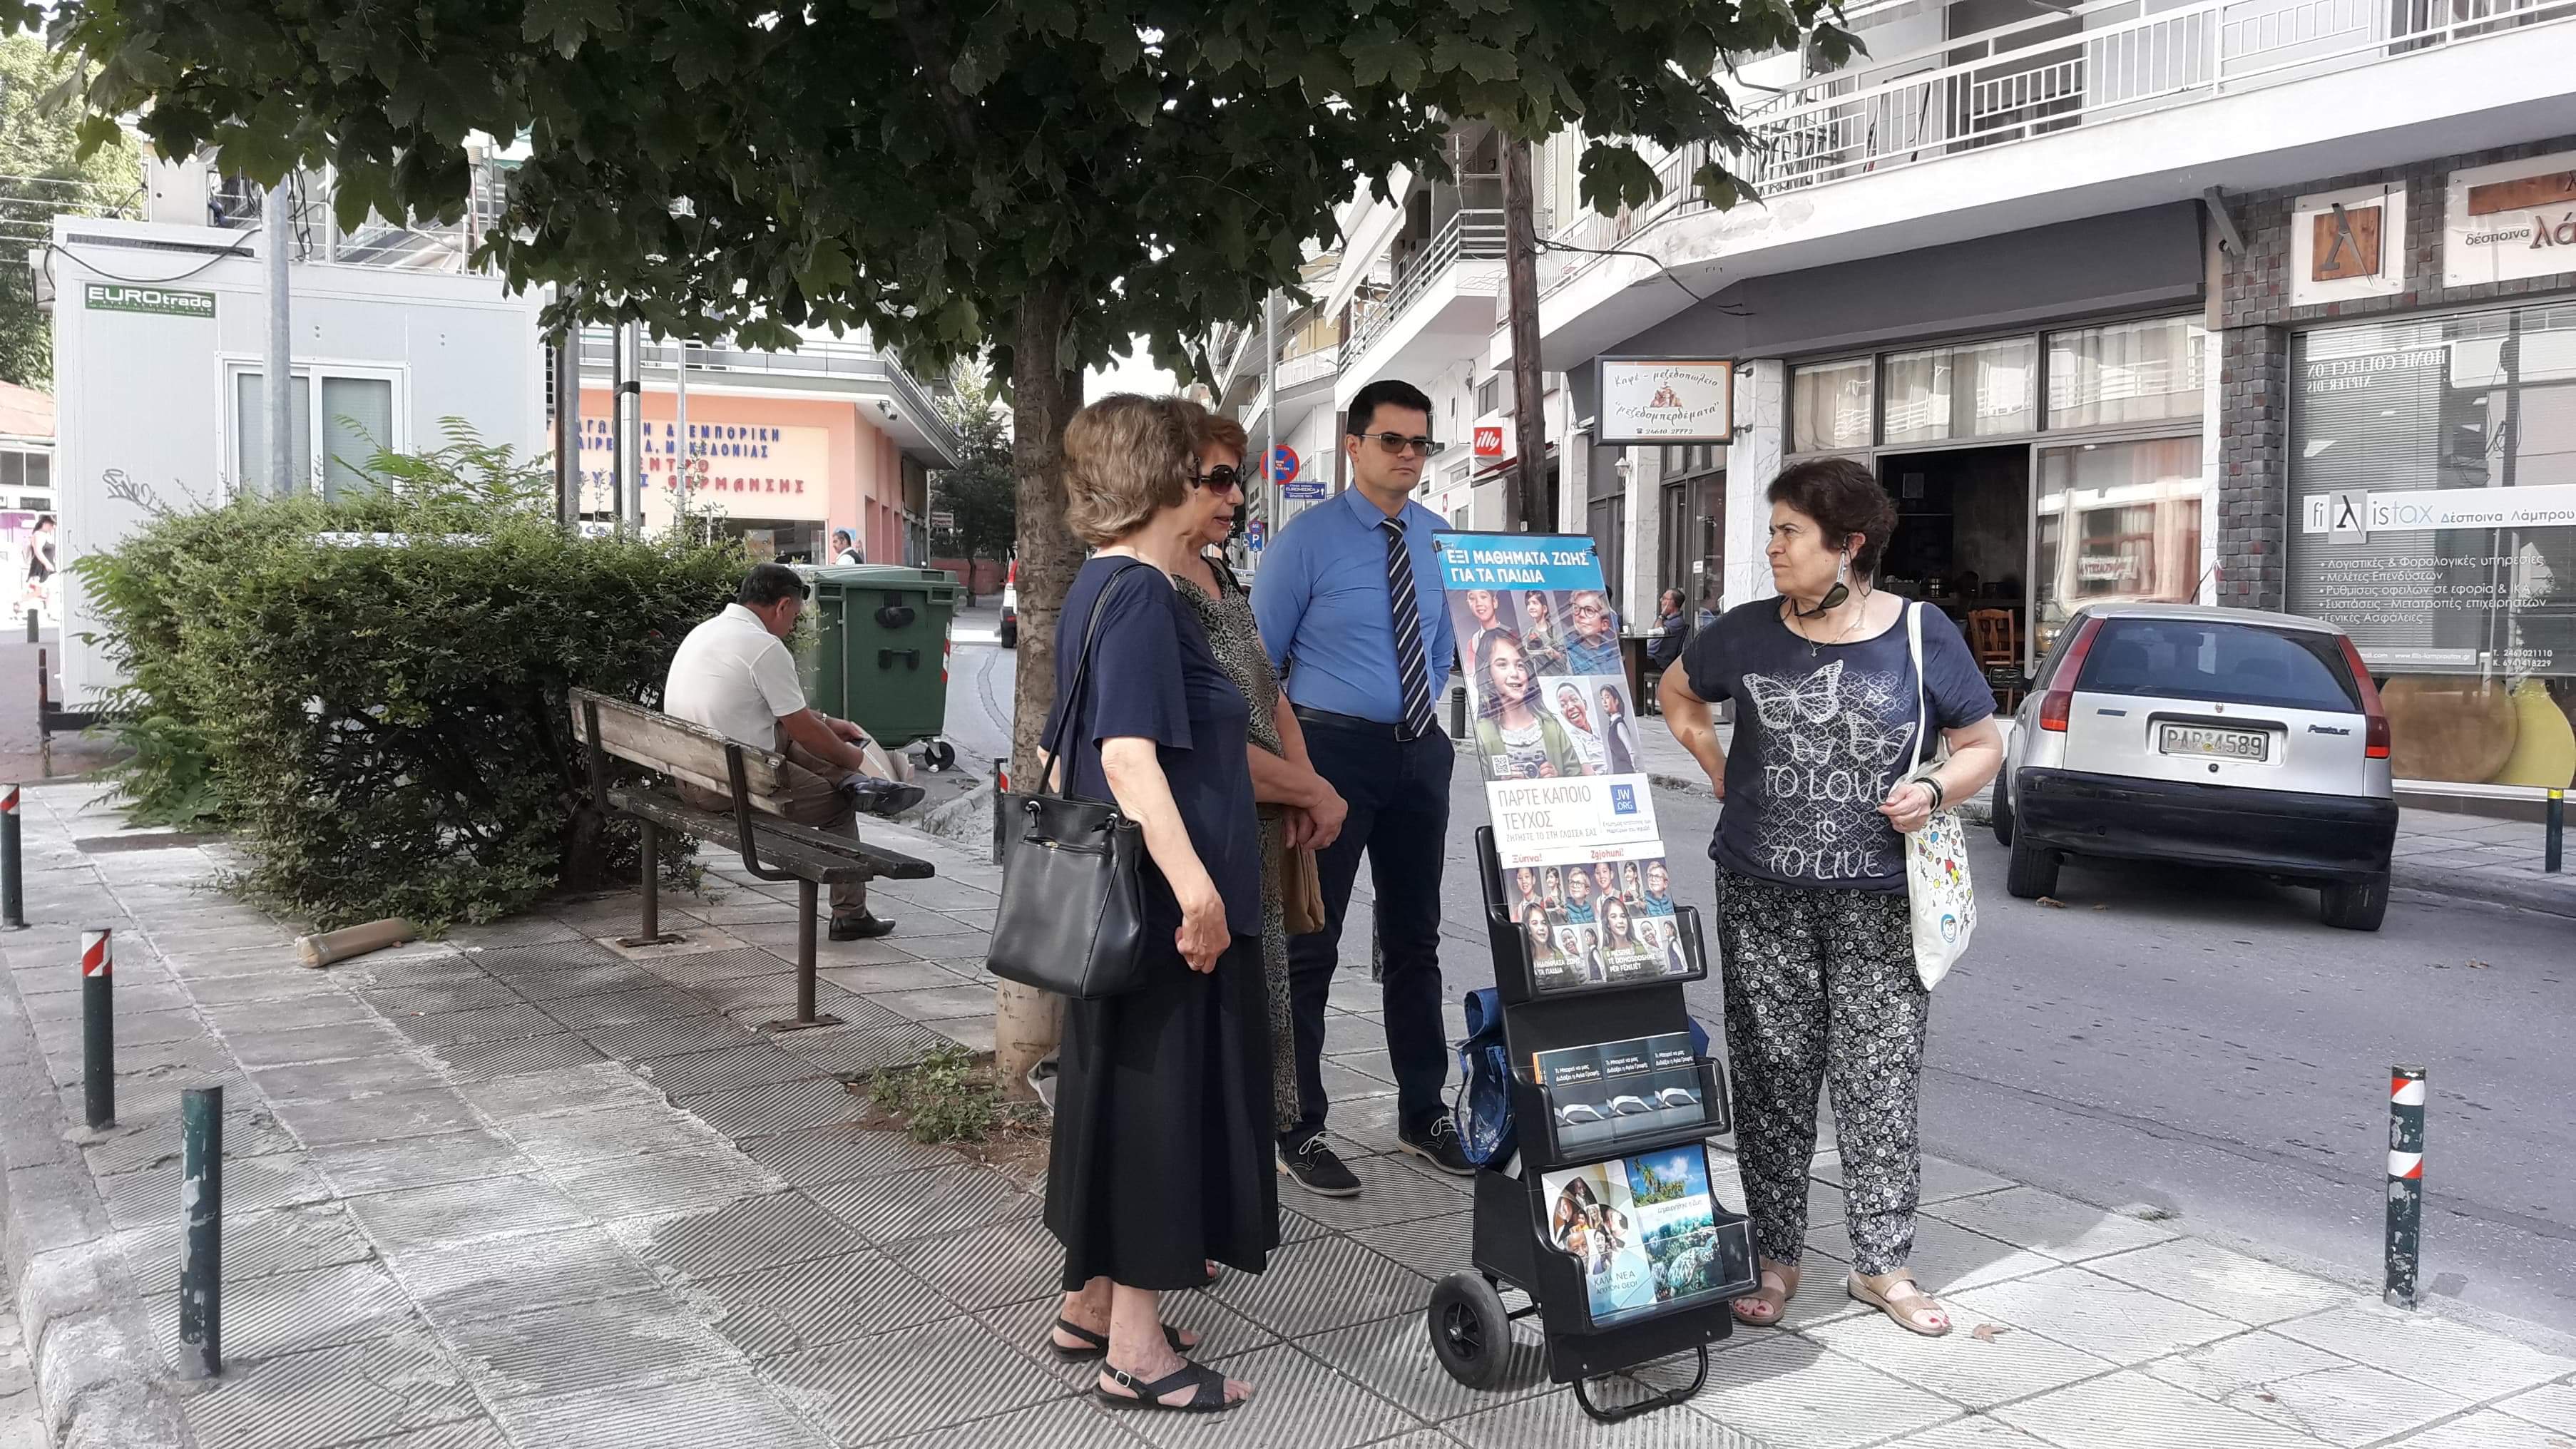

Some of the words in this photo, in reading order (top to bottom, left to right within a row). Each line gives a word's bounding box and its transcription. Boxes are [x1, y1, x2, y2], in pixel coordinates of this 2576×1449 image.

[2465, 228, 2530, 246] δέσποινα
[88, 287, 213, 308] EUROtrade
[1614, 372, 1640, 388] Καφέ
[1653, 367, 1718, 386] μεζεδοπωλείο
[665, 423, 675, 438] &
[689, 424, 780, 442] ΕΜΠΟΡΙΚΗ
[1476, 430, 1500, 451] illy
[665, 440, 768, 459] ΜΚΕΔΟΝΙΑΣ
[2440, 511, 2503, 523] Δέσποινα
[2510, 508, 2575, 523] Λάμπρου
[1252, 535, 1259, 544] P
[1446, 549, 1470, 565] ΕΞΙ
[1473, 550, 1550, 565] ΜΑΘΗΜΑΤΑ
[1552, 551, 1590, 566] ΖΩΗΣ
[2327, 557, 2385, 570] Λογιστικές
[2388, 558, 2396, 568] &
[2480, 553, 2545, 568] υπηρεσίες
[1451, 568, 1474, 583] ΓΙΑ
[1475, 568, 1493, 583] ΤΑ
[1497, 568, 1546, 583] ΠΑΙΔΙΑ
[2326, 572, 2369, 583] Μελέτες
[2381, 584, 2428, 596] οφειλών
[2433, 585, 2448, 594] σε
[2450, 583, 2494, 597] εφορία
[2498, 583, 2507, 595] &
[2325, 598, 2381, 611] Συστάσεις
[2391, 598, 2462, 611] Μετατροπές
[2363, 612, 2423, 625] Ασφάλειες
[2214, 733, 2262, 756] 4589
[1764, 765, 1799, 798] TO
[1809, 768, 1891, 804] LOVE
[1498, 788, 1540, 807] ΠΑΡΤΕ
[1543, 785, 1592, 804] ΚΑΠΟΙΟ
[1616, 789, 1630, 801] JW
[1502, 810, 1553, 830] ΤΕΥΧΟΣ
[1585, 828, 1598, 836] ΣΑΣ
[1511, 853, 1543, 864] Ξύπνα!
[1769, 846, 1804, 878] TO
[1815, 849, 1885, 880] LIVE
[1615, 1269, 1636, 1281] ΝΕΑ
